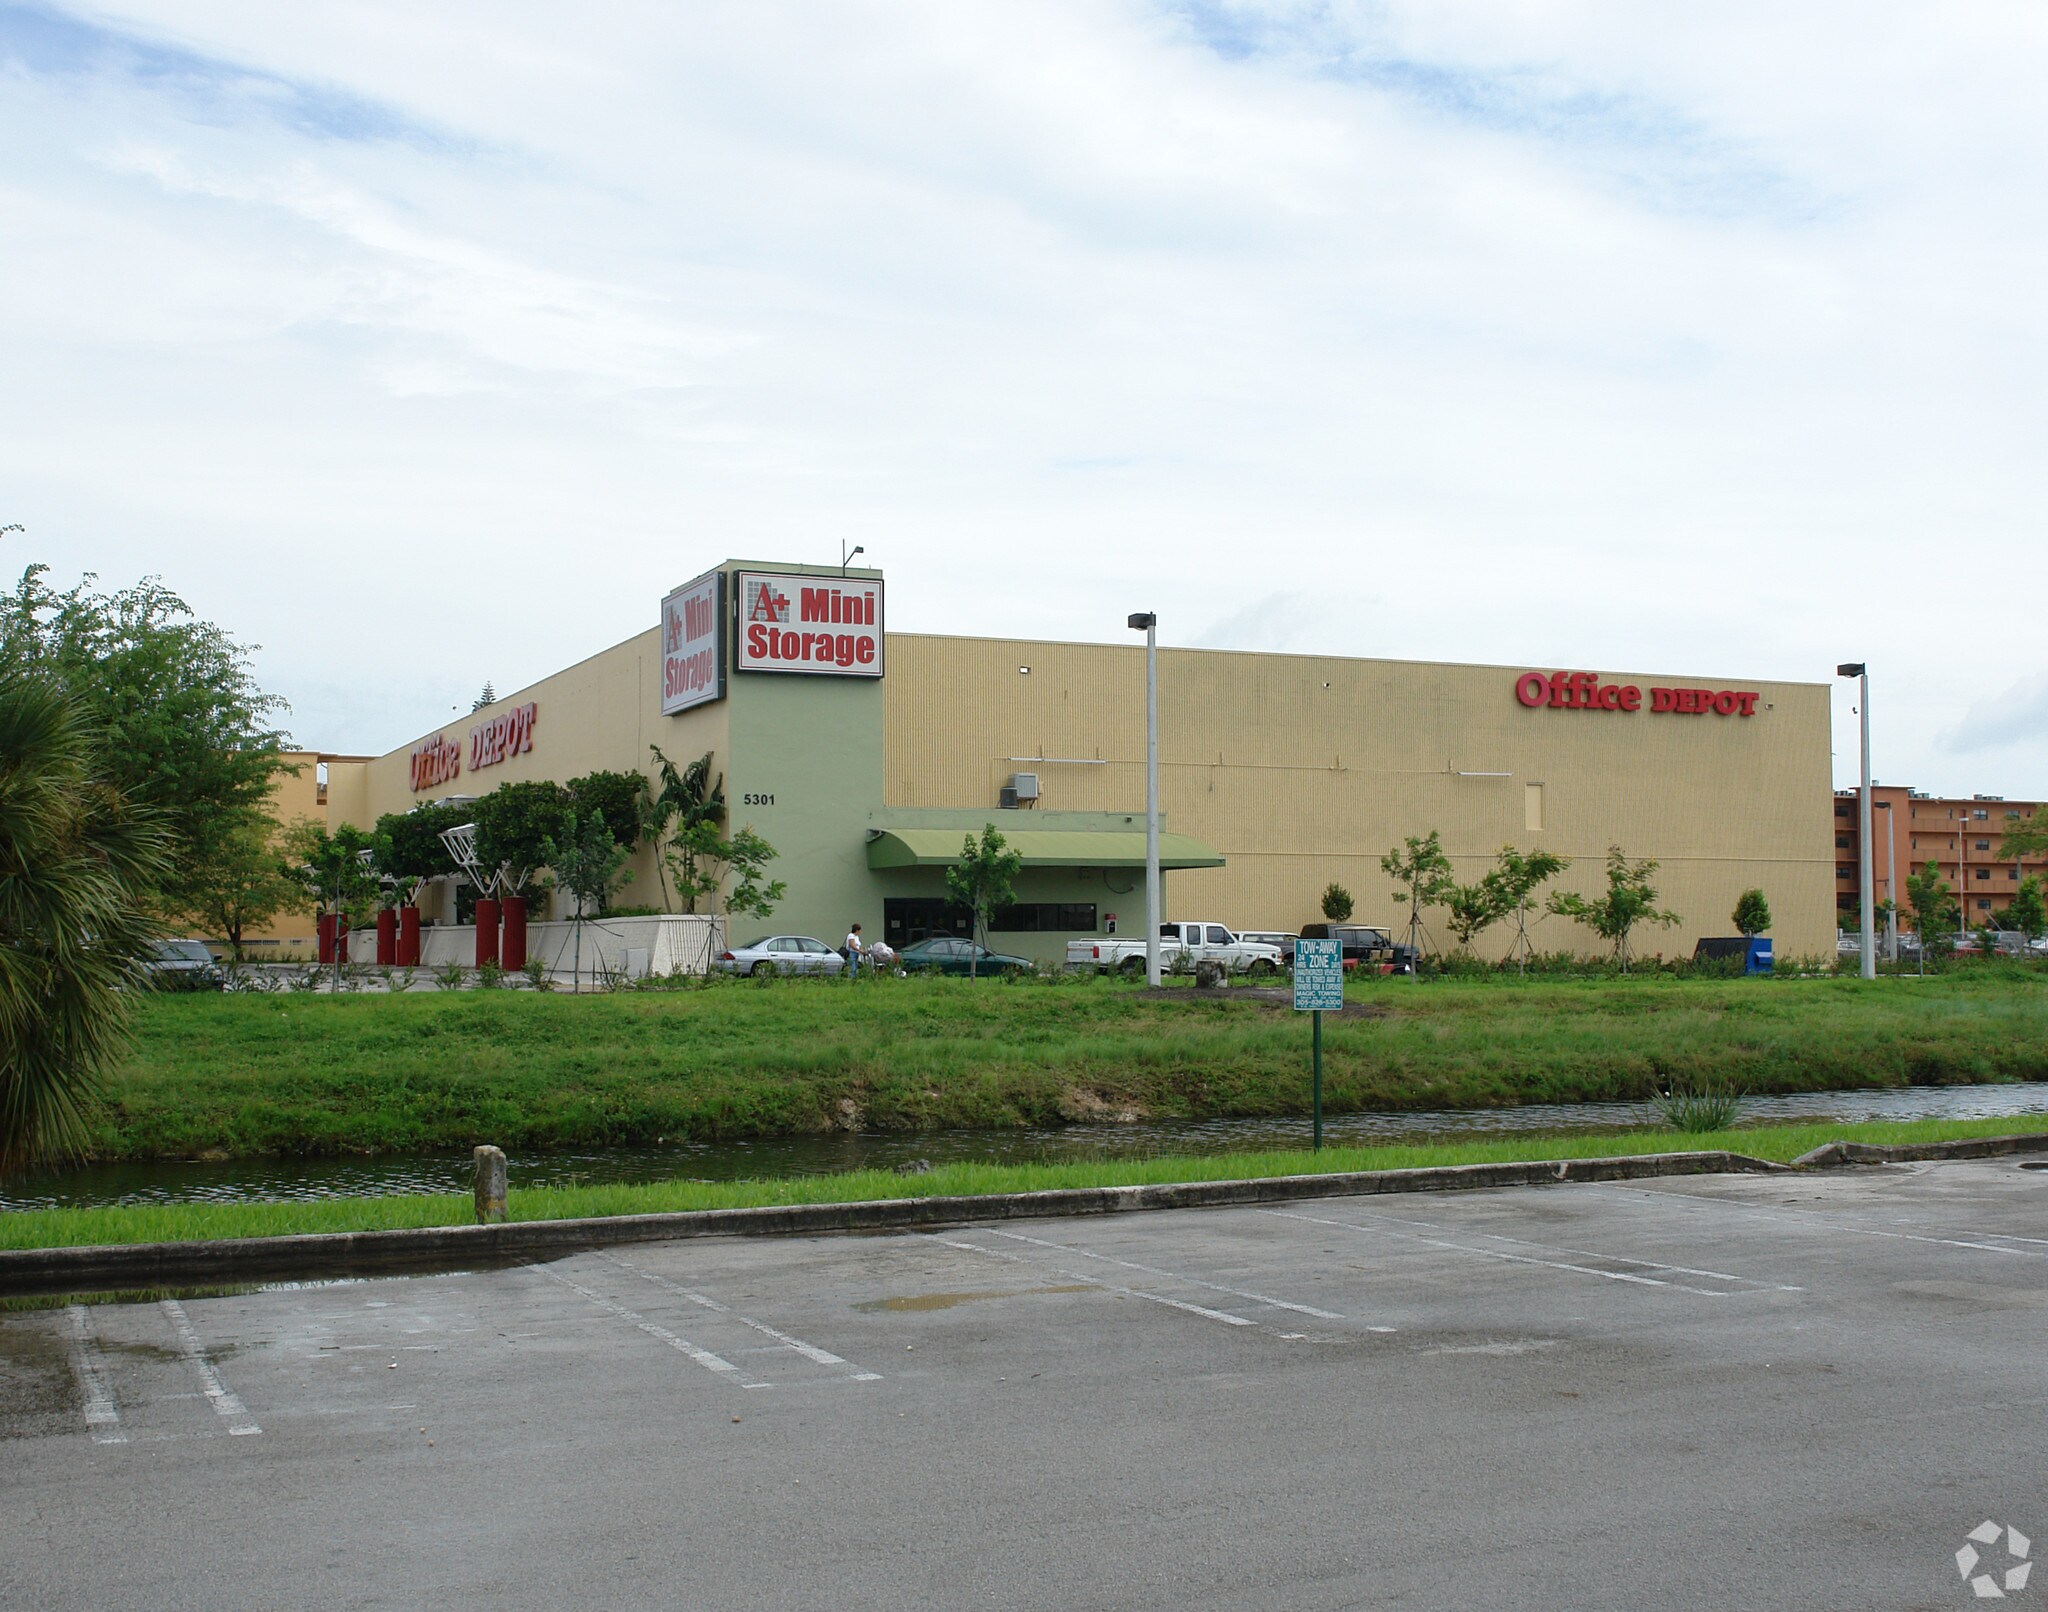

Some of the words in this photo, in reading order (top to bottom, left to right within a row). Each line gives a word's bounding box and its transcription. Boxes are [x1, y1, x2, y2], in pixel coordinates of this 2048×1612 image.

[684, 589, 713, 643] Mini
[749, 582, 790, 622] A+
[800, 587, 875, 625] Mini
[747, 623, 875, 667] Storage
[665, 646, 713, 699] Storage
[1515, 671, 1642, 712] Office
[1650, 687, 1759, 716] DEPOT
[409, 733, 461, 792] Office
[467, 701, 537, 771] DEPOT
[744, 794, 775, 805] 5301
[1300, 941, 1337, 954] TOW-AWAY
[1309, 955, 1329, 968] ZONE
